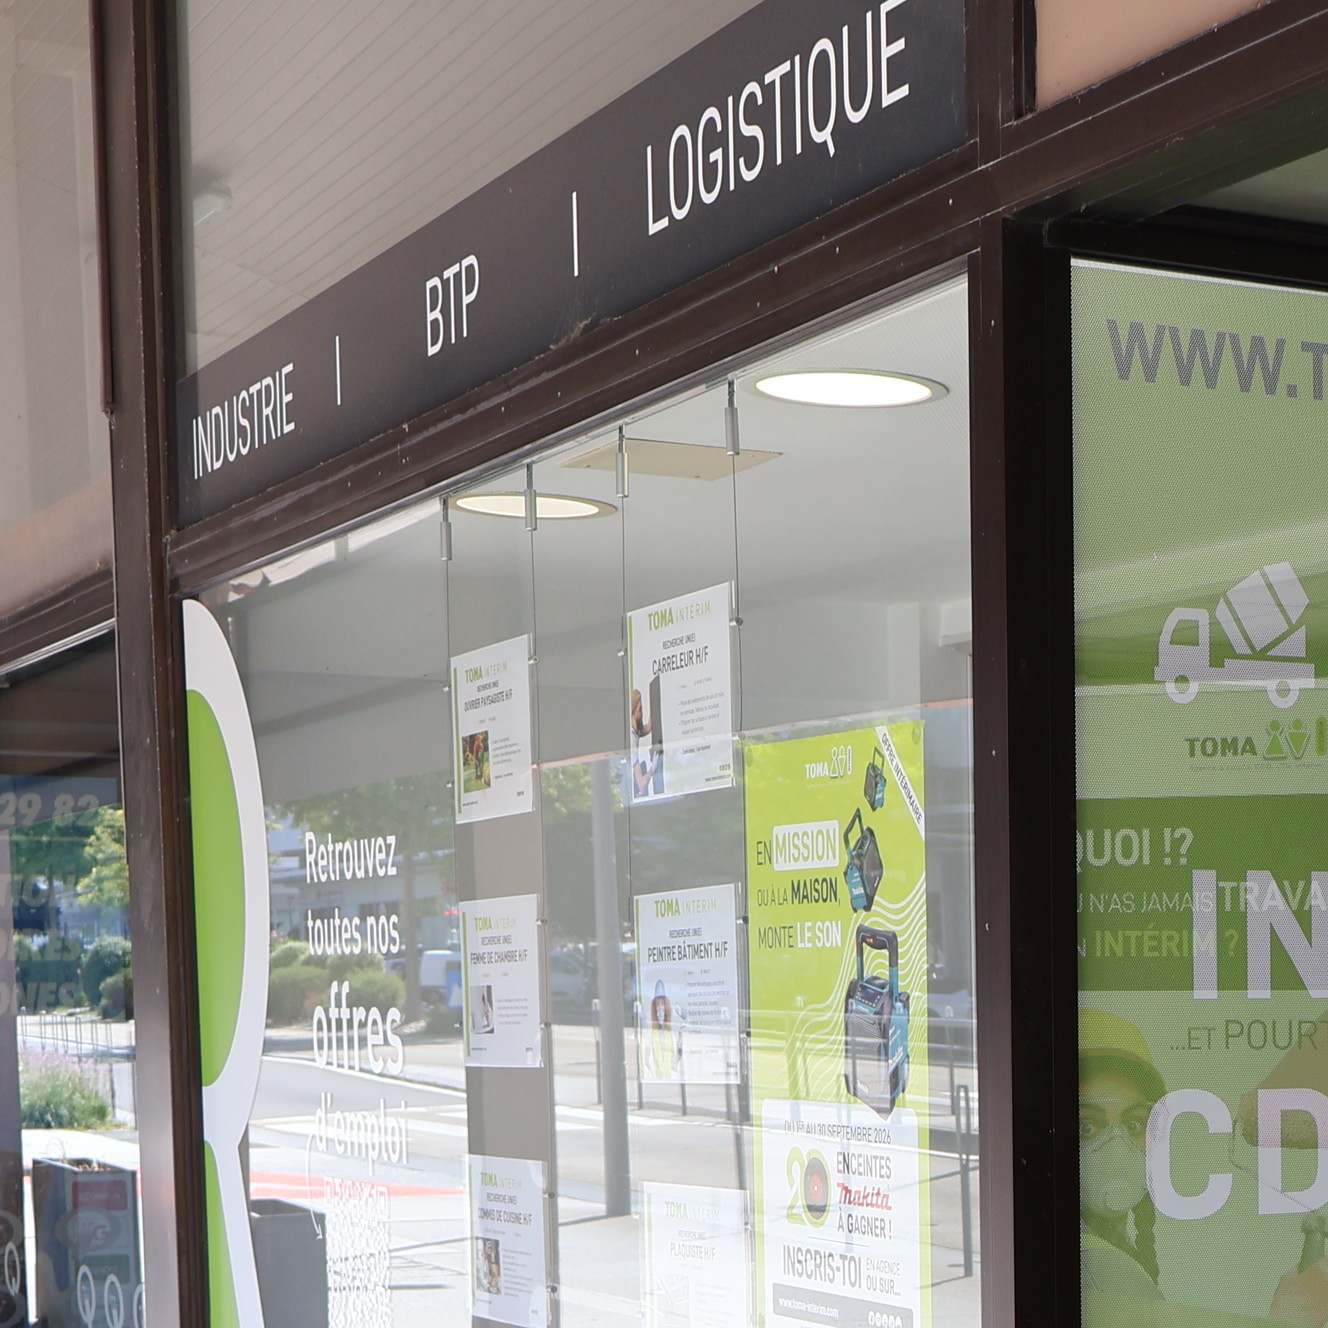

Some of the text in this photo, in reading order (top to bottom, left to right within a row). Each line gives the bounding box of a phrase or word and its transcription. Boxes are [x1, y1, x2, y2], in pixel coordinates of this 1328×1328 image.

[193, 363, 295, 480] INDUSTRIE
[425, 254, 480, 357] BTP
[646, 0, 910, 236] LOGISTIQUE
[647, 601, 711, 631] TOMA INTERIM
[652, 645, 709, 676] CARRELEUR H/F
[465, 665, 483, 684] TOMA
[1185, 736, 1257, 758] TOMA
[805, 761, 829, 779] TOMA
[881, 732, 923, 825] OFFRE INTÉRIMAIRE
[305, 831, 398, 884] Retrouvez
[756, 826, 838, 866] EN MISSION
[757, 887, 770, 907] OU
[777, 886, 788, 905] LA
[791, 877, 841, 907] MAISON,
[1140, 889, 1215, 912] JAMAIS
[654, 898, 717, 918] TOMA INTERIM
[307, 907, 400, 956] toutes nos
[474, 917, 493, 933] TOMA
[758, 920, 842, 949] MONTE LE SON
[648, 940, 728, 964] PEINTRE BÂTIMENT H/F
[1094, 923, 1216, 958] INTÉRIM
[494, 950, 518, 964] CHAMBRE
[312, 980, 404, 1076] offres
[315, 1091, 409, 1177] d'emploi
[827, 1125, 872, 1145] SEPTEMBRE
[836, 1152, 892, 1180] ENCEINTES
[480, 1172, 498, 1188] TOMA
[664, 1201, 688, 1219] TOMA
[847, 1213, 886, 1239] GAGNER
[670, 1242, 703, 1260] PLAQUISTE
[783, 1244, 862, 1290] INSCRIS-TOI
[865, 1257, 901, 1277] EN AGENCE
[866, 1275, 878, 1291] OU
